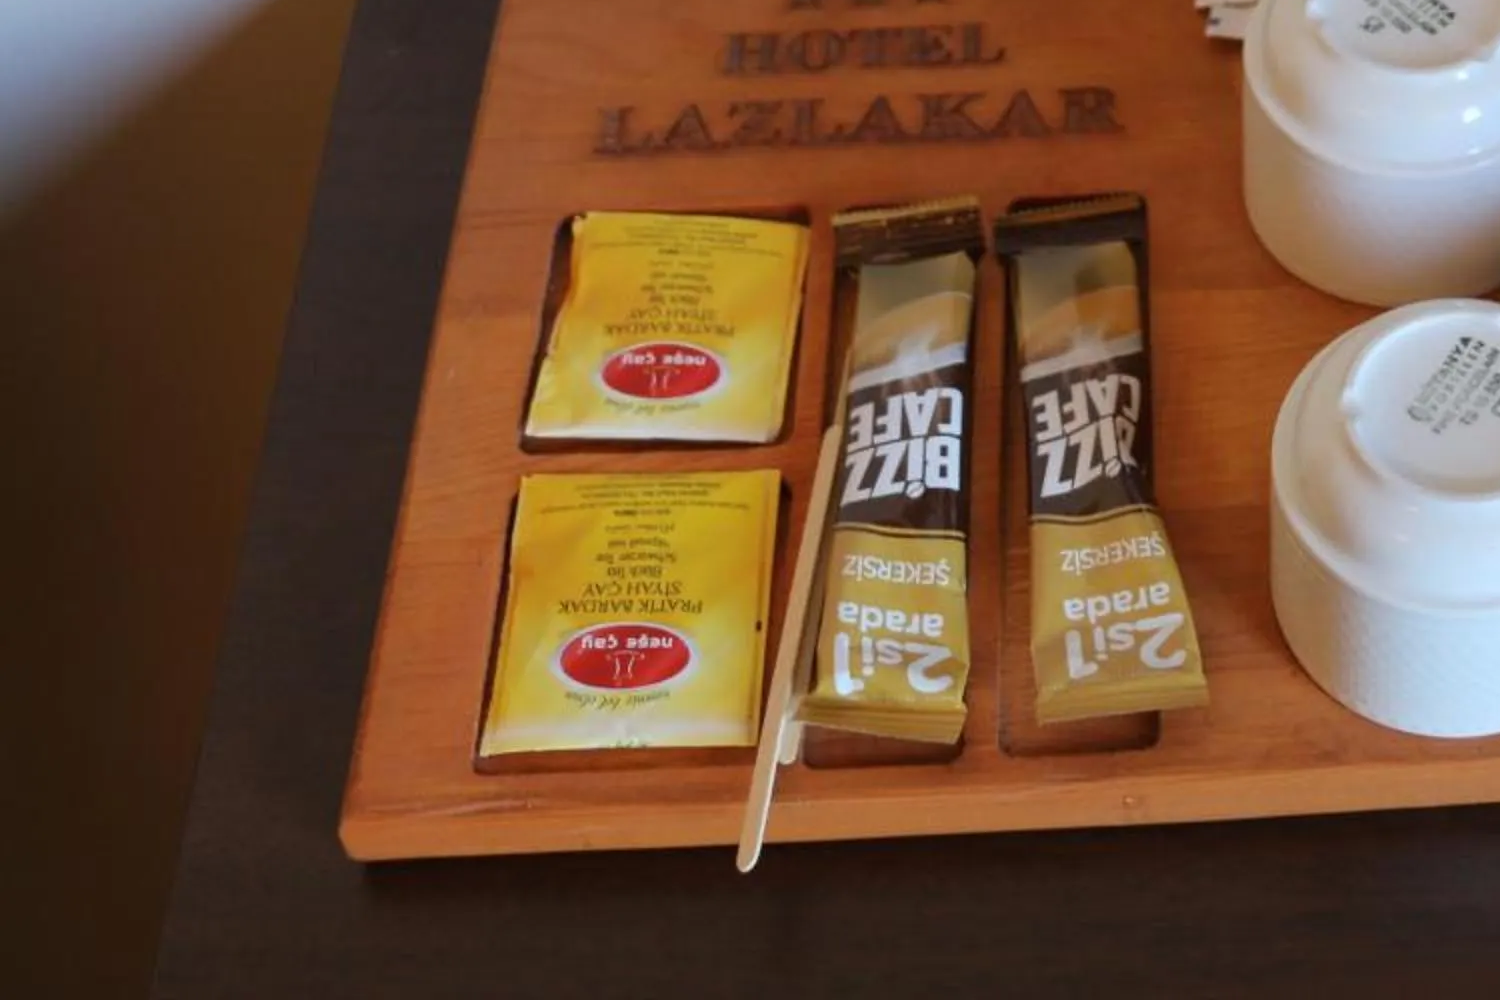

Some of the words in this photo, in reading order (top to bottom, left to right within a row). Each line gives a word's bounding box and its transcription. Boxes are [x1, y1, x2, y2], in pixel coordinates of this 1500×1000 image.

[722, 21, 1007, 76] HOTEL
[592, 83, 1127, 157] LAZLAKAR
[845, 385, 963, 451] CAFE
[1030, 373, 1140, 443] CAFE
[557, 599, 634, 614] BARDAK
[583, 580, 622, 597] ÇAY
[638, 599, 704, 614] PRATİK
[1062, 580, 1172, 625] arada
[627, 633, 673, 649] neşe
[836, 600, 945, 641] arada
[580, 634, 618, 649] çay
